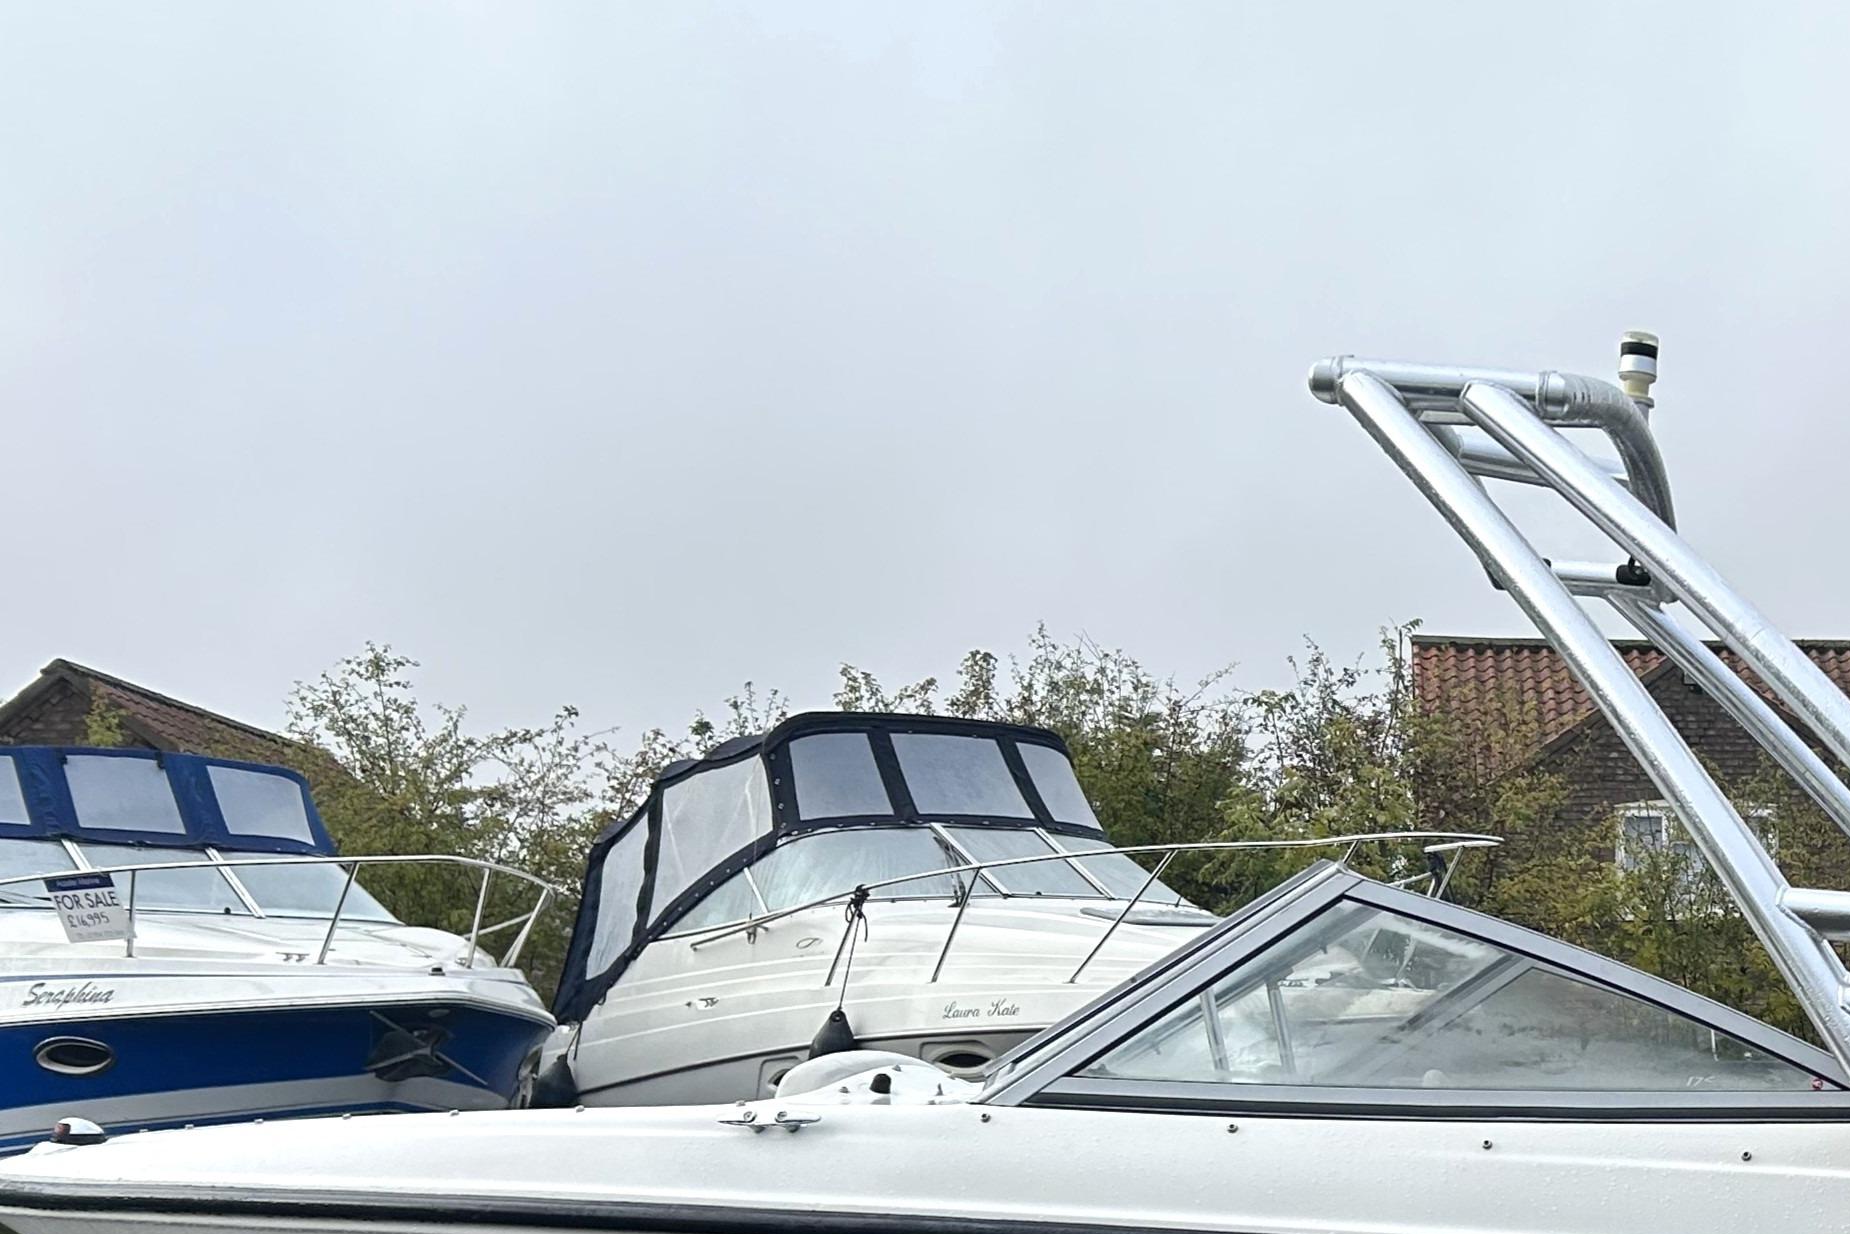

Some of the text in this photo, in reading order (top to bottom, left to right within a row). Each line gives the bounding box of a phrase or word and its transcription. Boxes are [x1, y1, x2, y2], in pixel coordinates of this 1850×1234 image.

[54, 891, 119, 911] FOR SALE
[22, 981, 115, 1011] Seraphina
[942, 998, 1020, 1019] Laura Kate
